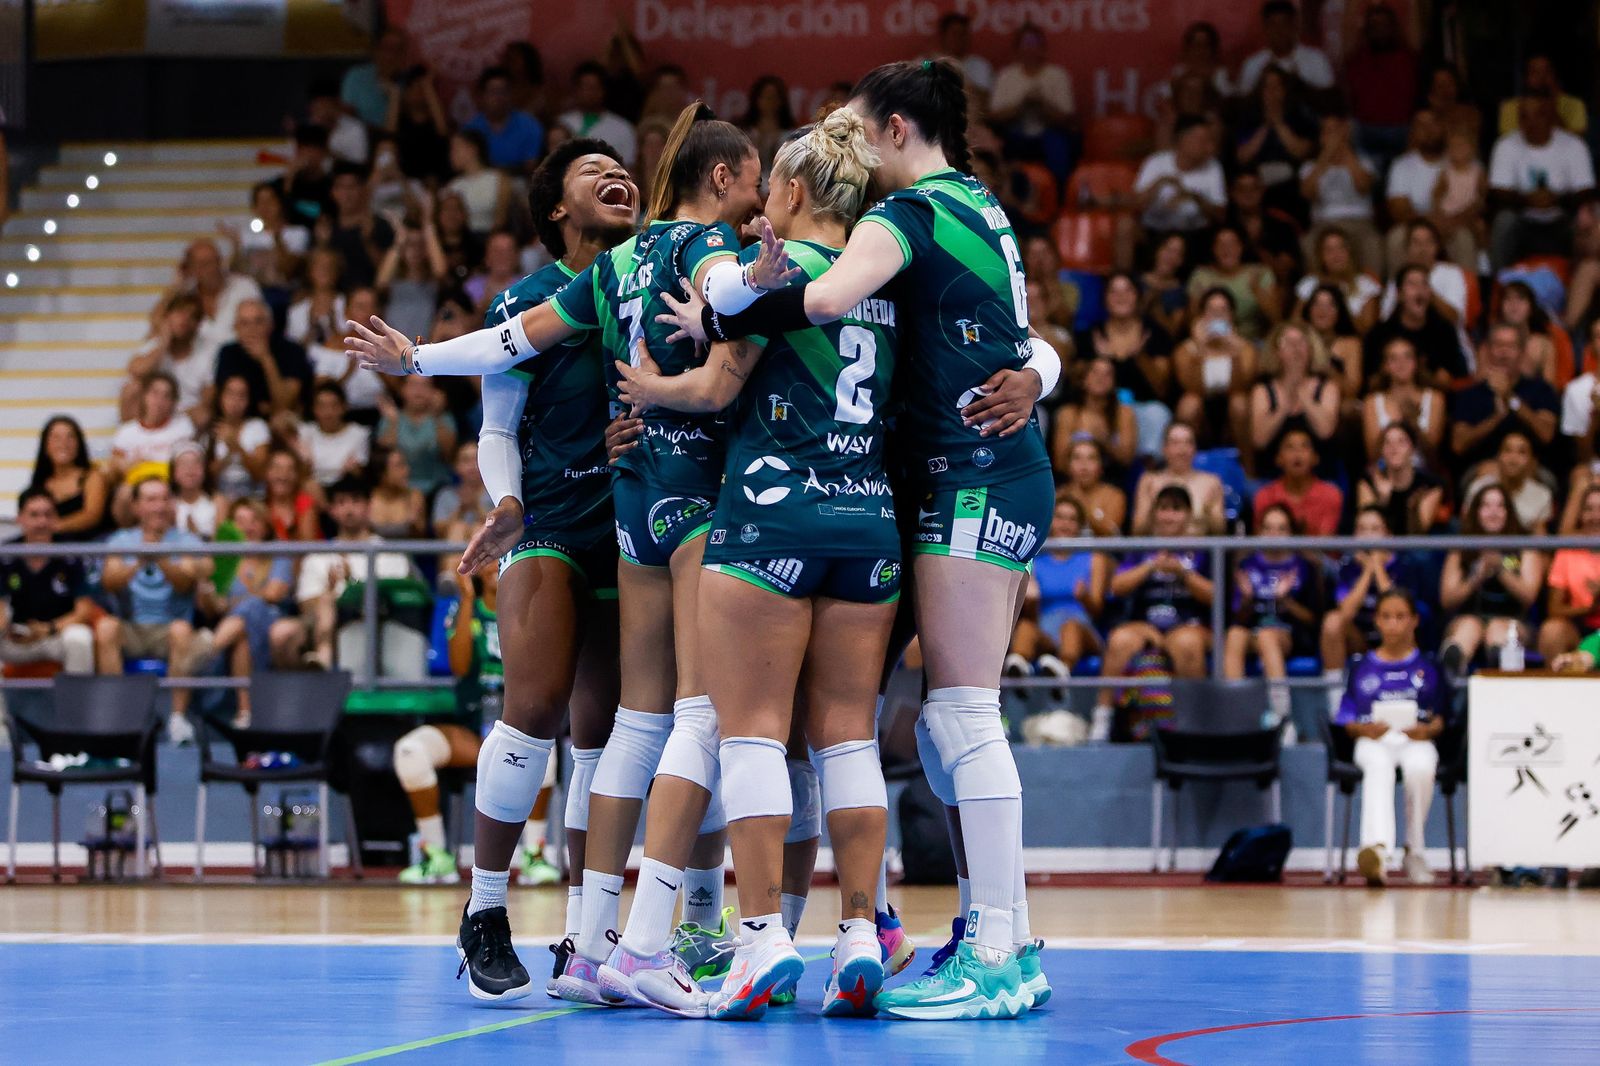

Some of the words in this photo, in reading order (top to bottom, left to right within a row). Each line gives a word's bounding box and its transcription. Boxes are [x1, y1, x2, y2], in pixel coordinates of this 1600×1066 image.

[884, 0, 938, 36] de
[1000, 233, 1029, 329] 6
[500, 328, 518, 357] SP
[619, 296, 645, 369] 7
[834, 325, 877, 425] 2
[827, 432, 874, 455] WAY
